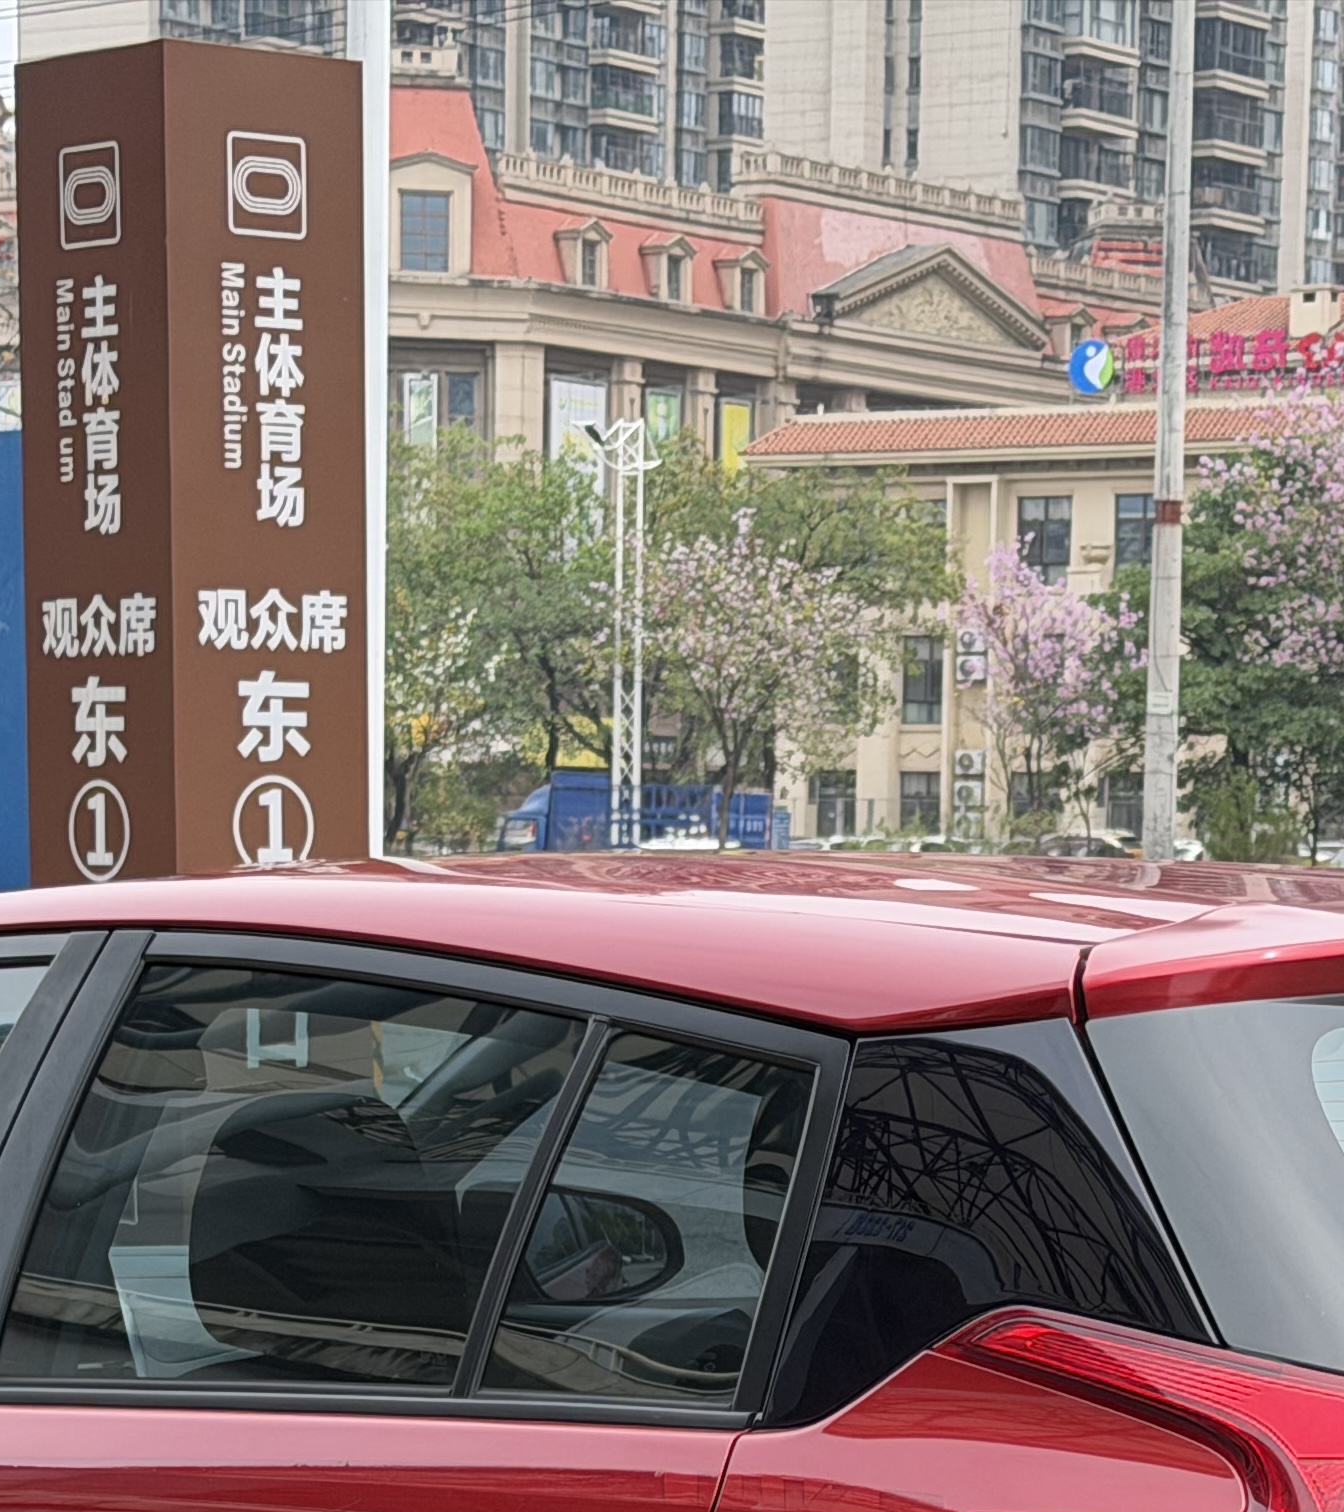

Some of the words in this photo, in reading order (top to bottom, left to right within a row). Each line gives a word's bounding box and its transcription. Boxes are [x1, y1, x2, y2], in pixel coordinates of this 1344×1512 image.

[57, 278, 75, 351] Main
[221, 261, 246, 336] Main
[81, 274, 122, 535] 主体育场
[222, 342, 248, 469] Stadium
[254, 266, 306, 528] 主体育场
[41, 592, 158, 660] 观众席
[197, 588, 349, 655] 观众席
[71, 675, 128, 768] 东
[236, 669, 311, 763] 东
